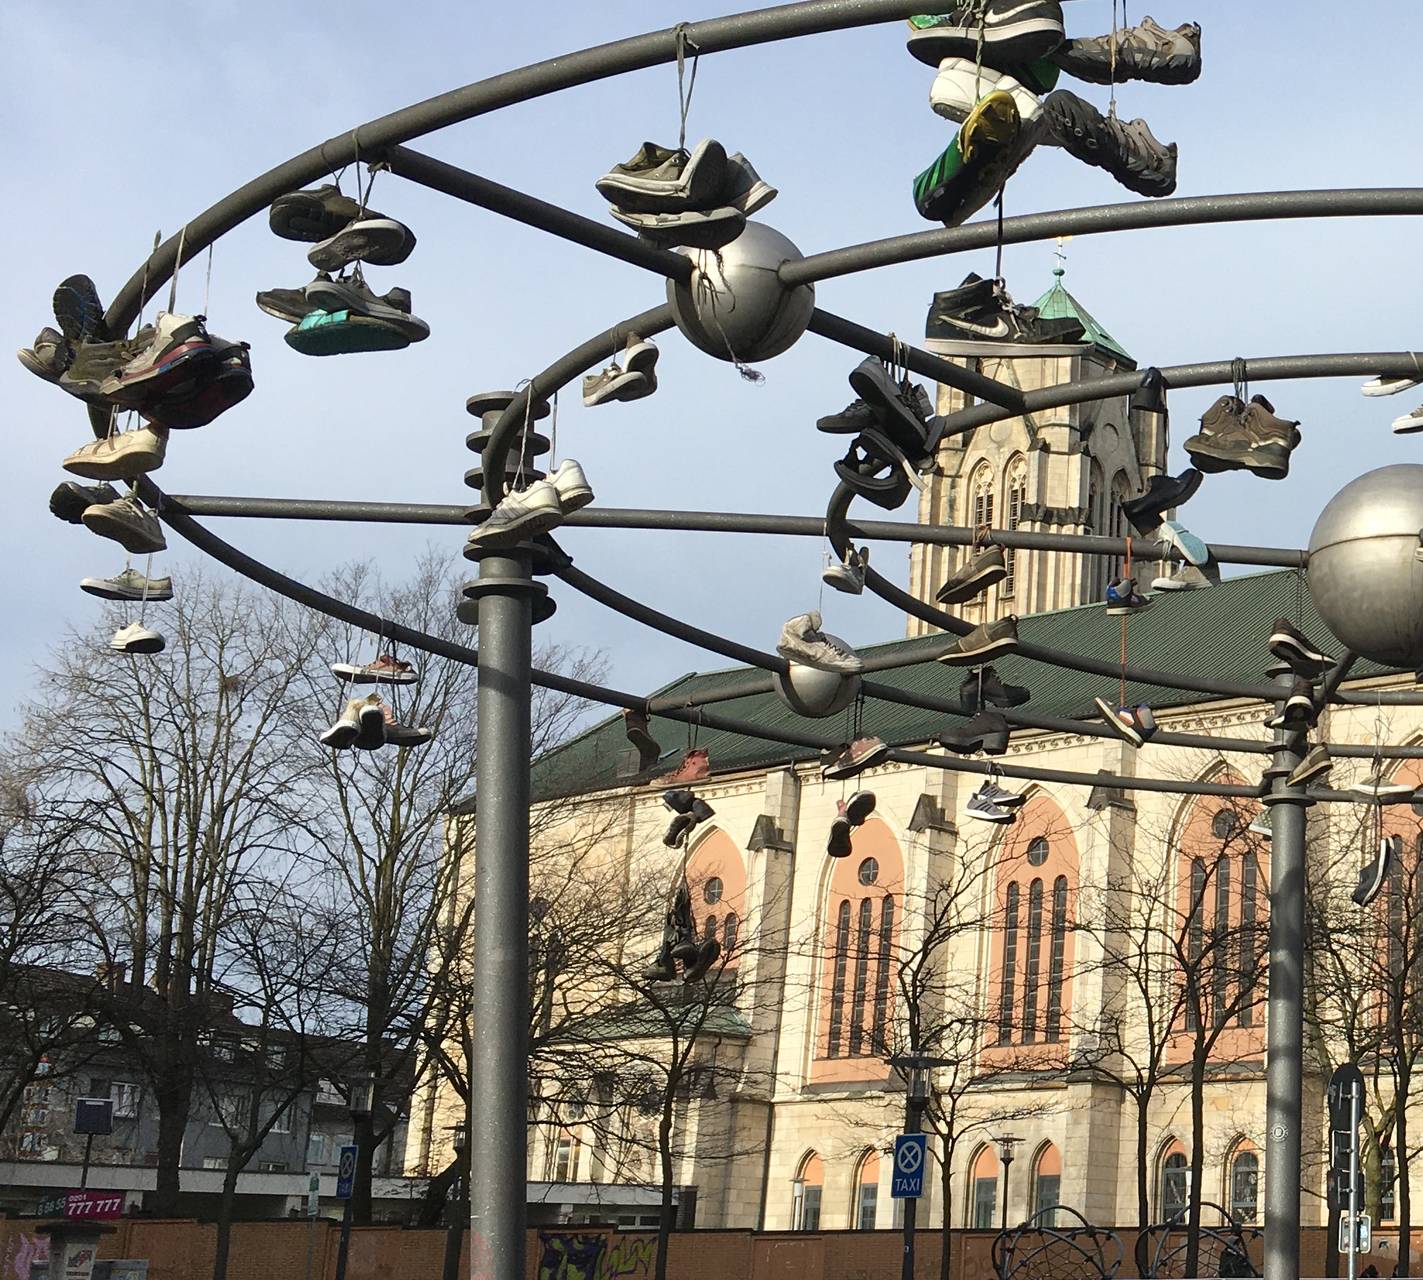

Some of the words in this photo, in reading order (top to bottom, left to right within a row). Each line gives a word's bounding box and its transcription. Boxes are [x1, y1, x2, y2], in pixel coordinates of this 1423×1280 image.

[895, 1178, 920, 1192] TAXI
[68, 1201, 94, 1216] 777
[96, 1198, 121, 1213] 777
